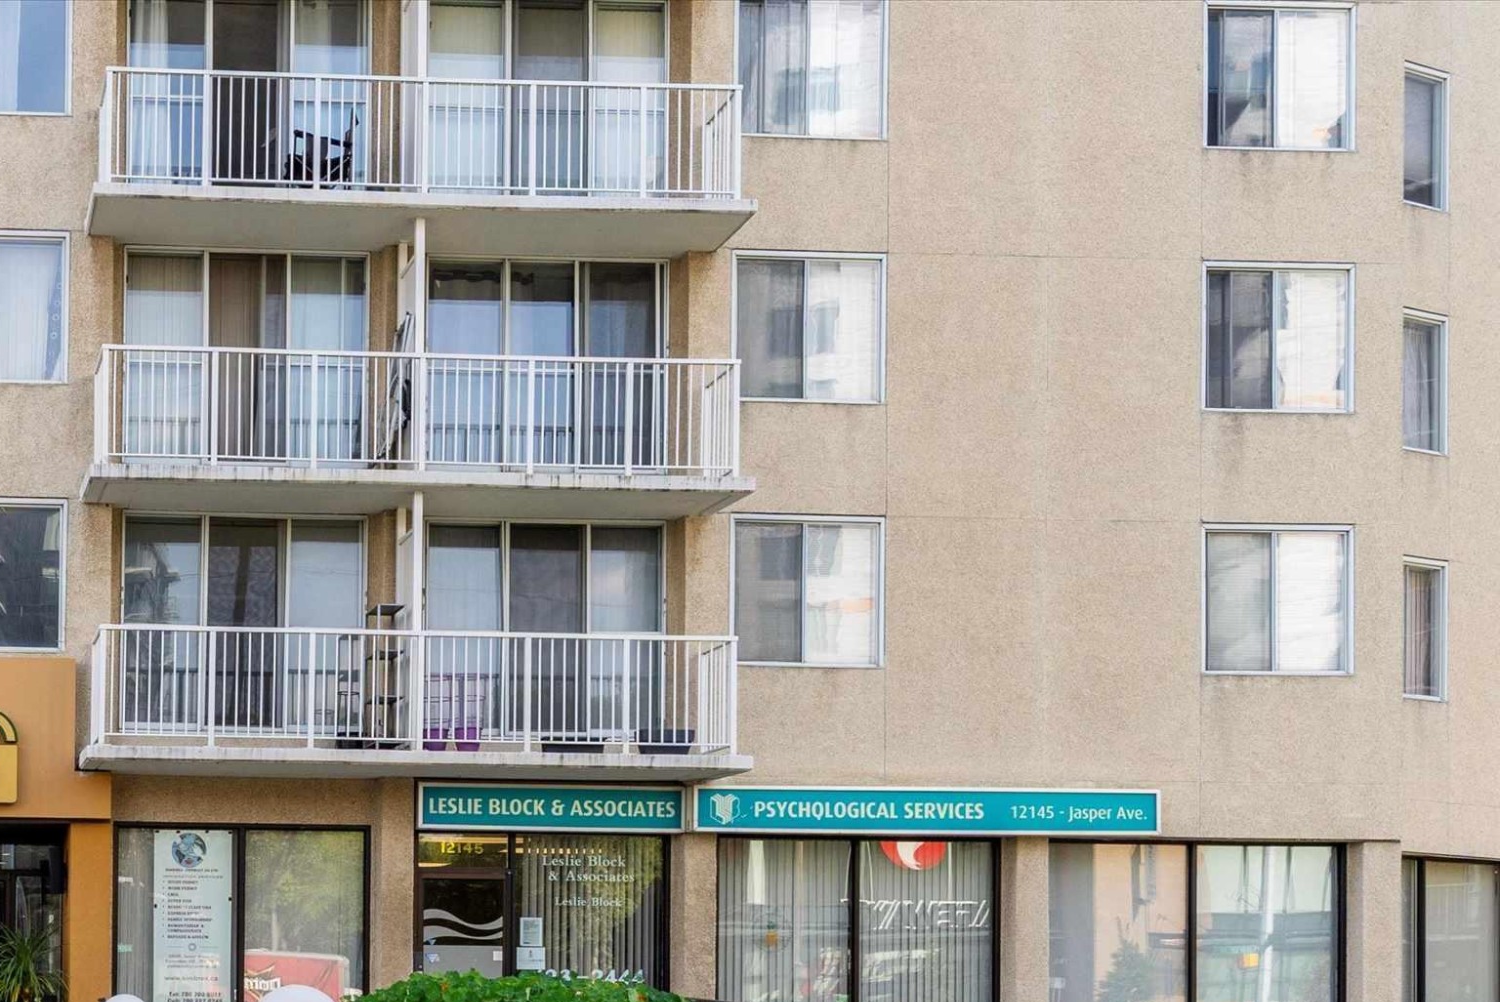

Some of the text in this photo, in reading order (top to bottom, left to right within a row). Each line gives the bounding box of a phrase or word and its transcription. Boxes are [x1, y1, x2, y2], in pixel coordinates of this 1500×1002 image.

[429, 797, 676, 818] LESLIE BLOCK & ASSOCIATES
[754, 801, 985, 820] PSYCHOLOGICAL SERVICES
[1010, 805, 1055, 819] 12145
[1068, 805, 1112, 823] Jasper
[1116, 806, 1148, 821] Ave.
[440, 841, 484, 855] 12145
[542, 855, 626, 868] Leslie Block
[548, 870, 635, 882] & Associates
[555, 896, 623, 907] Leslie Block
